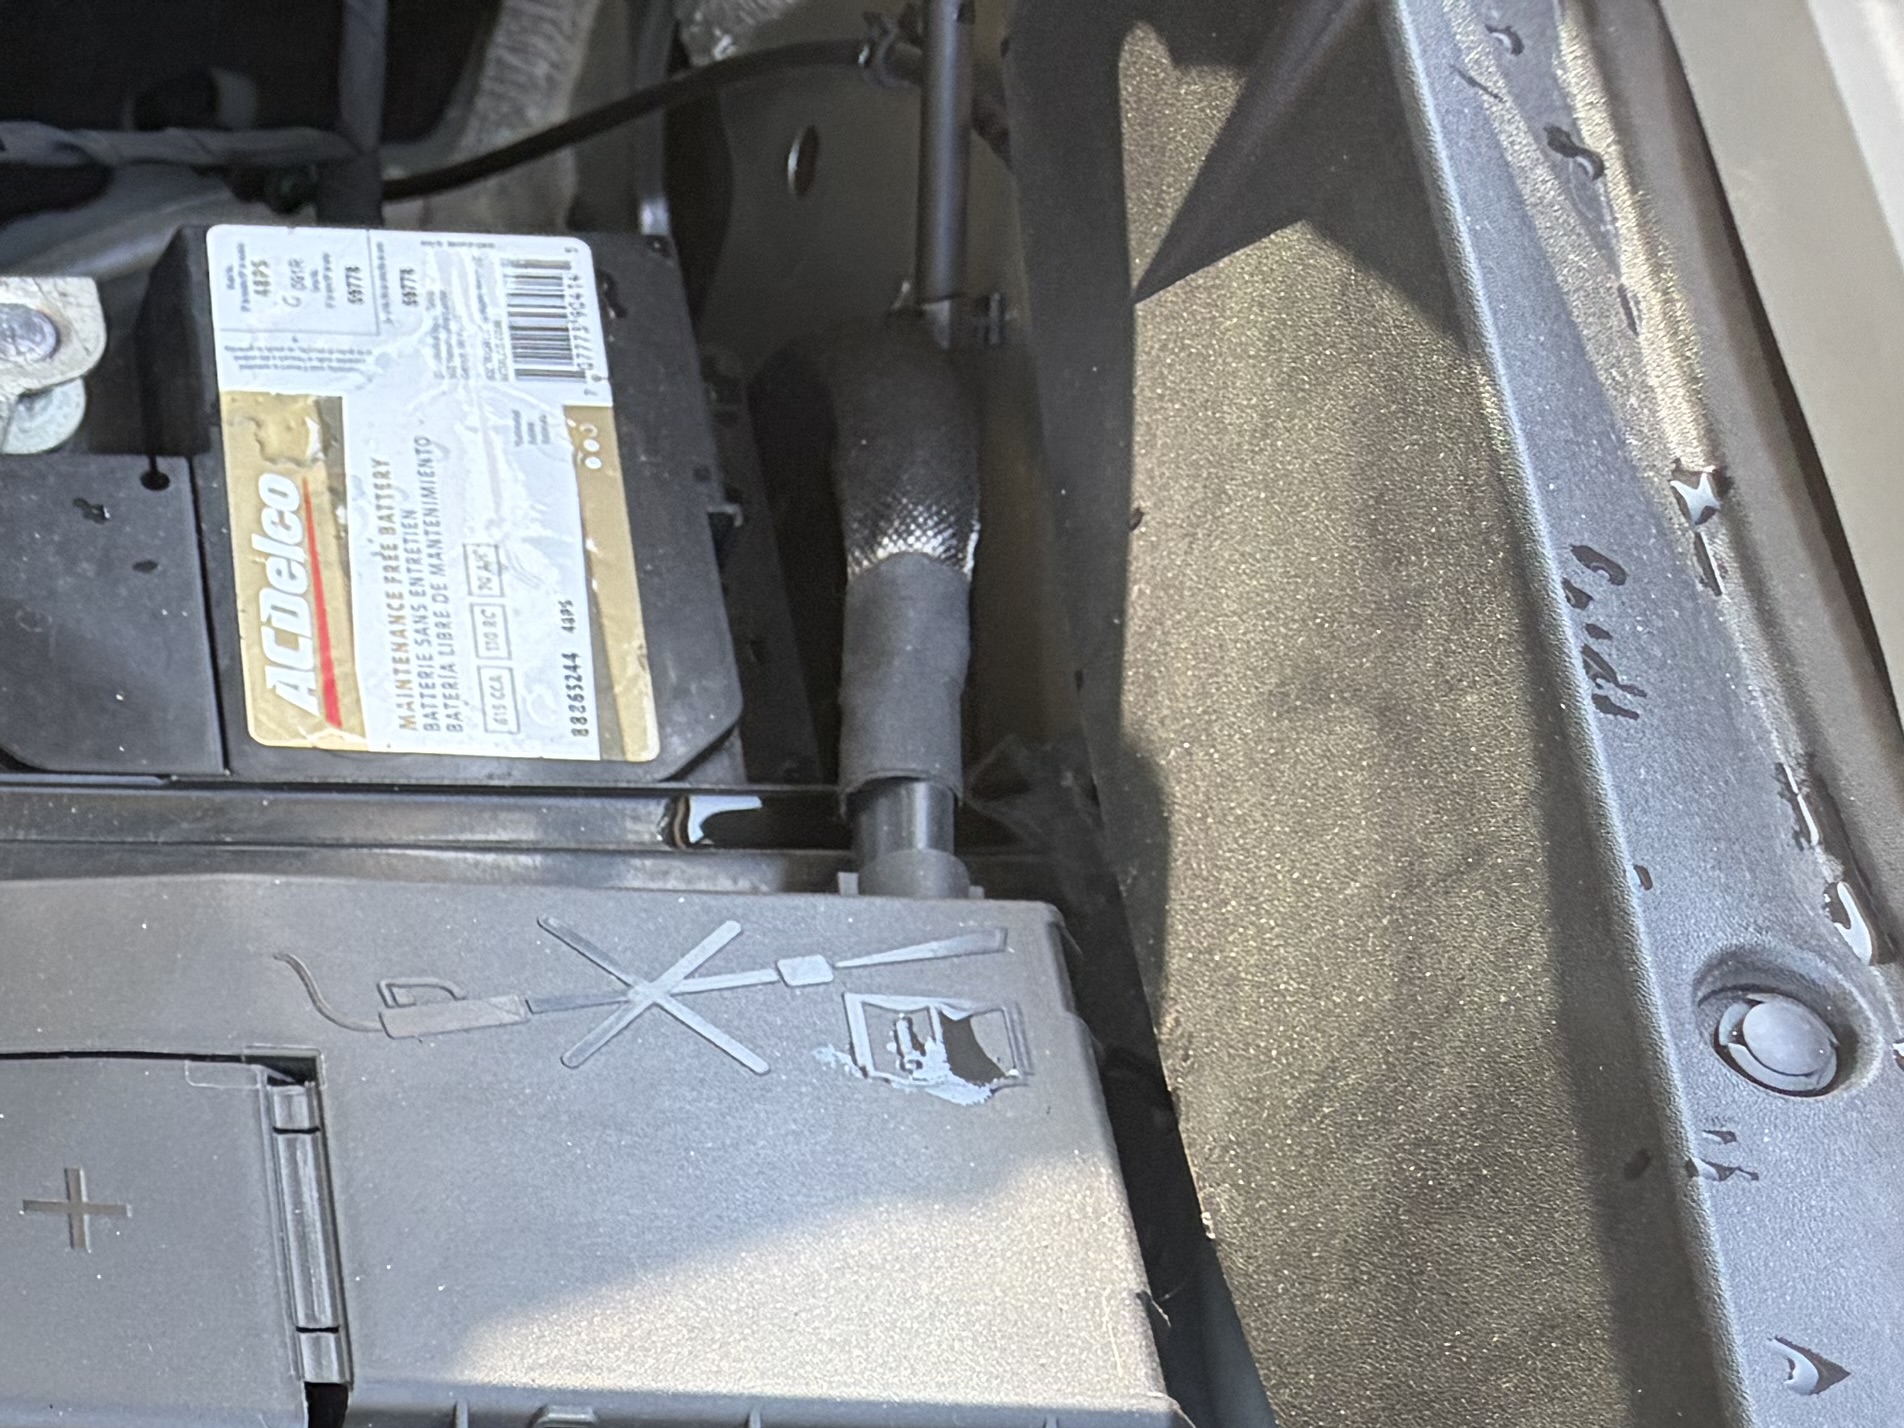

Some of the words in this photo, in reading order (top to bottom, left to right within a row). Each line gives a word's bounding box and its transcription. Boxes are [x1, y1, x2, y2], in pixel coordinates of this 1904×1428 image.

[370, 456, 397, 536] BATTERY
[414, 434, 446, 577] MANTENIMIENTO
[379, 538, 405, 584] FREE
[401, 508, 426, 599] ENTRETIEN
[431, 581, 450, 605] DE
[251, 472, 321, 718] ACDelco
[410, 603, 434, 648] SANS
[433, 608, 456, 656] LIBRE
[384, 591, 419, 732] MAINTENANCE
[415, 655, 441, 733] BATTERIE
